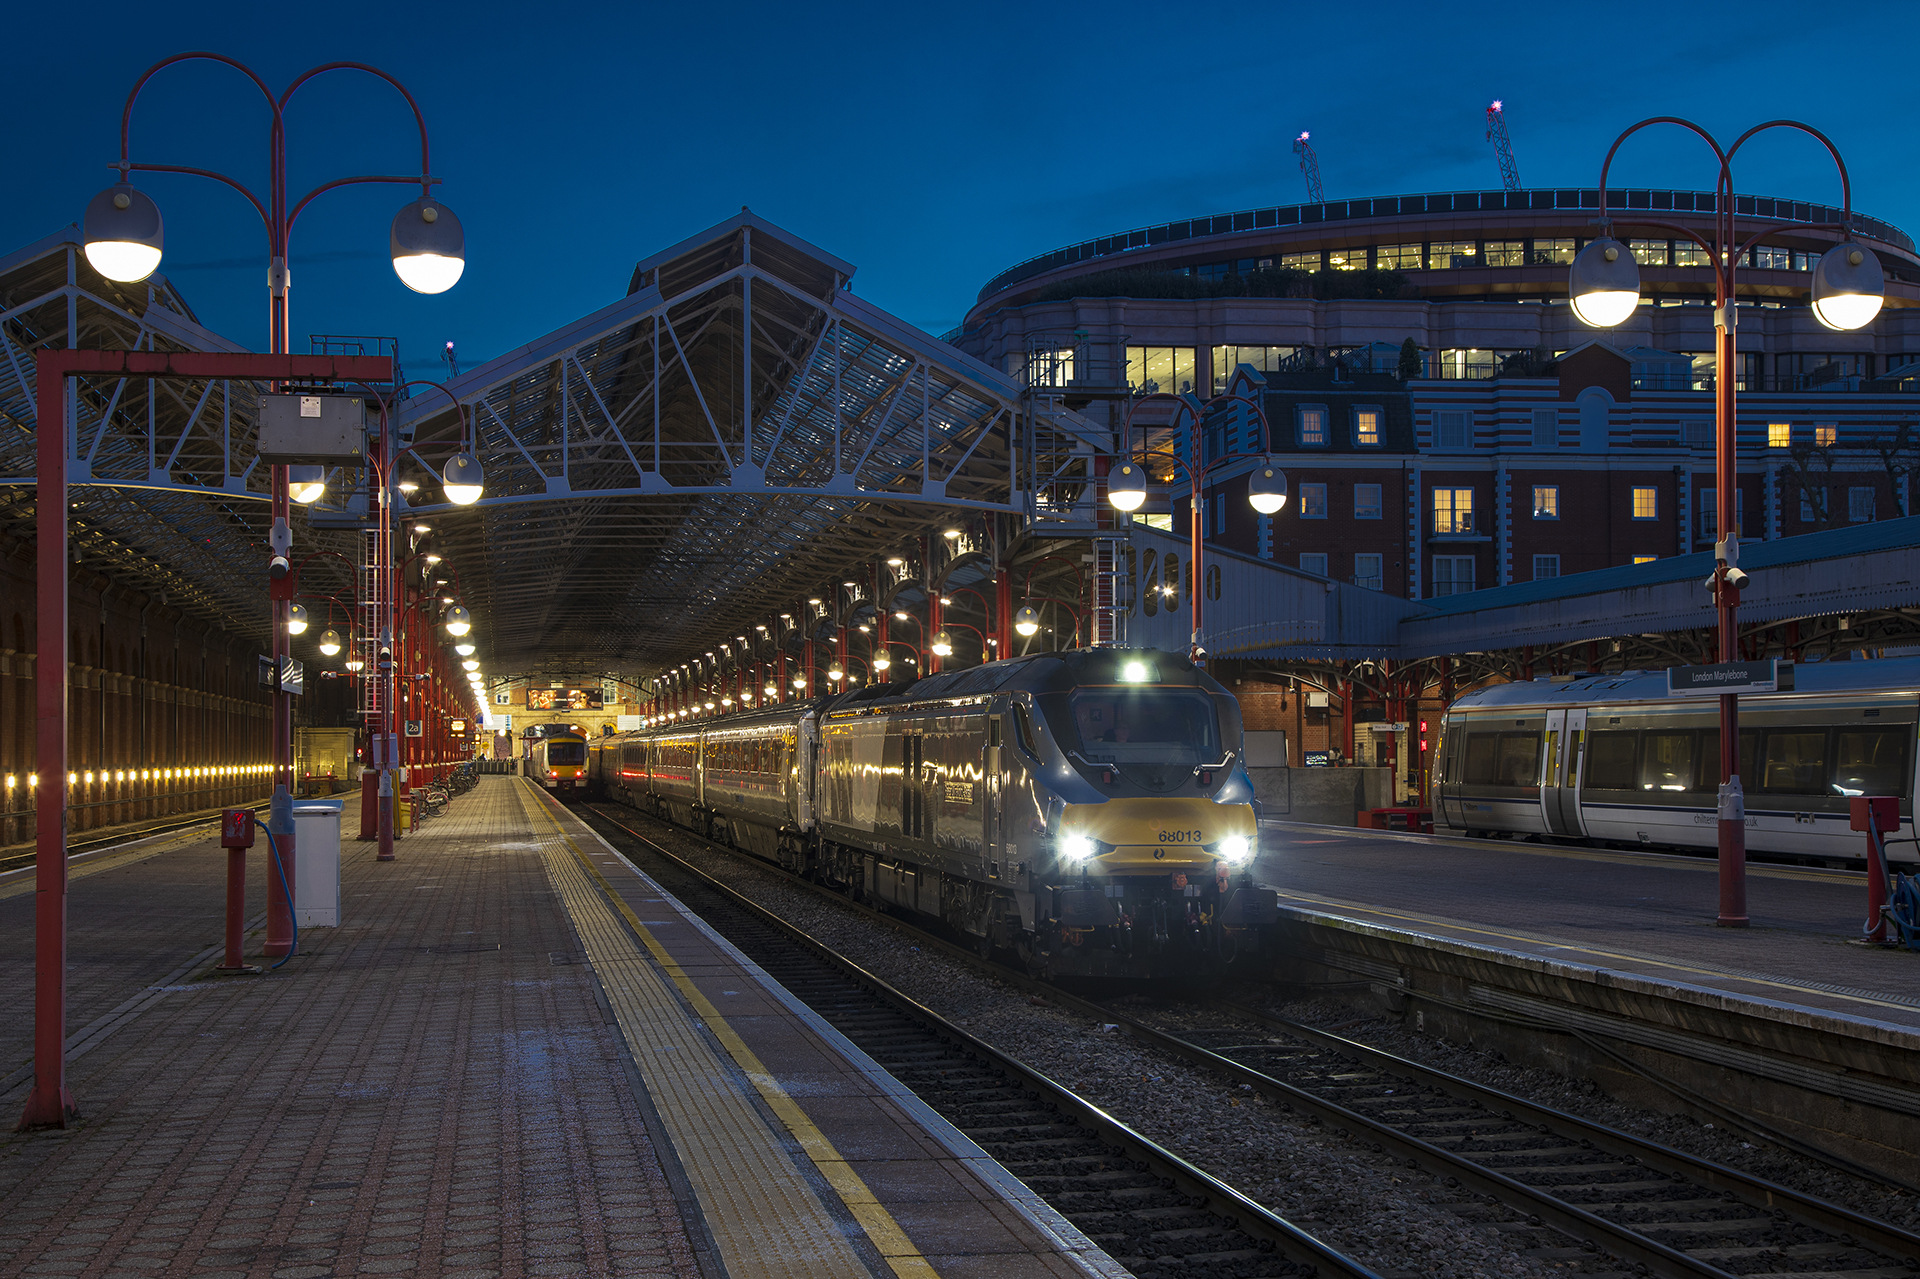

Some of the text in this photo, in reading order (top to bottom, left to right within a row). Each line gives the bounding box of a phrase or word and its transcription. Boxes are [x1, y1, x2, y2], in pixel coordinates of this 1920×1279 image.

[1692, 669, 1748, 682] London Marylebone
[409, 723, 419, 732] 2a
[1158, 830, 1202, 842] 68013
